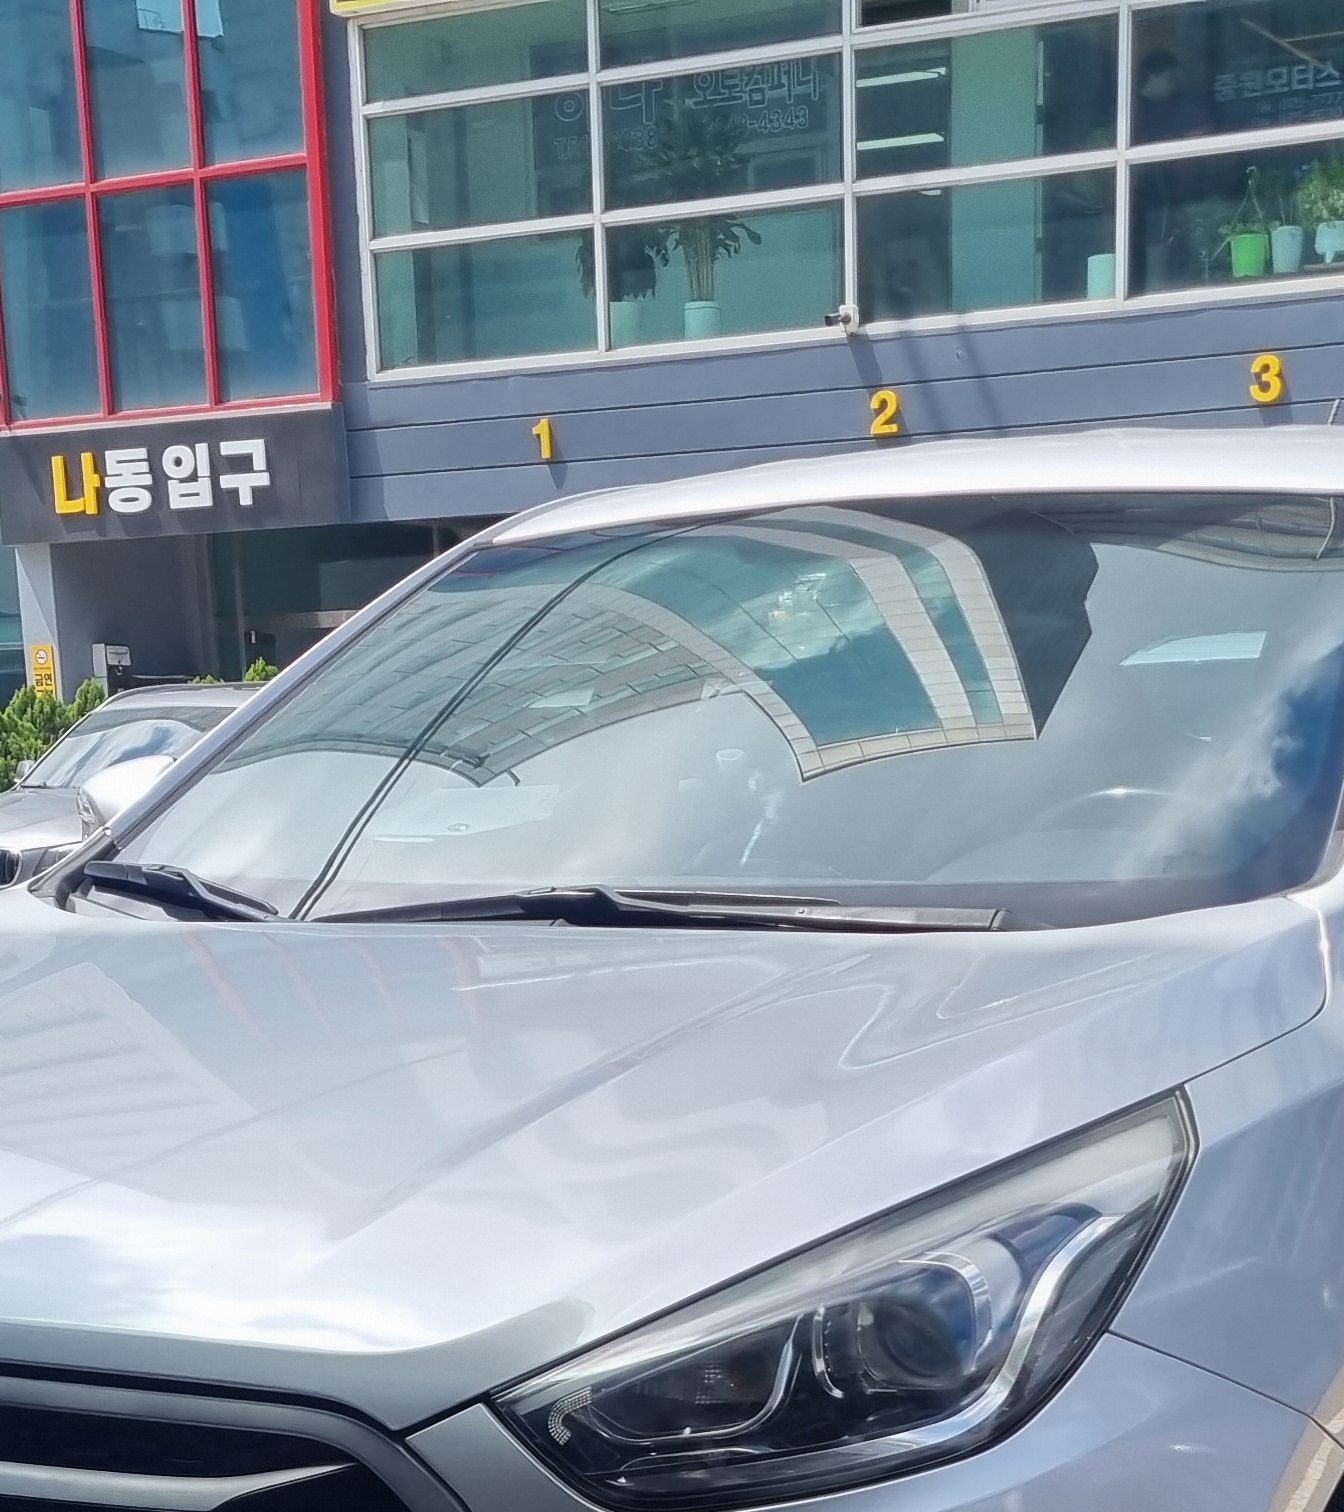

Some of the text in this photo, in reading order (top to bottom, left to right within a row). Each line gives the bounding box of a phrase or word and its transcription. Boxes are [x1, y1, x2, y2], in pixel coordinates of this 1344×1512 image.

[1250, 354, 1282, 402] 3
[870, 390, 899, 434] 2
[532, 418, 552, 459] 1
